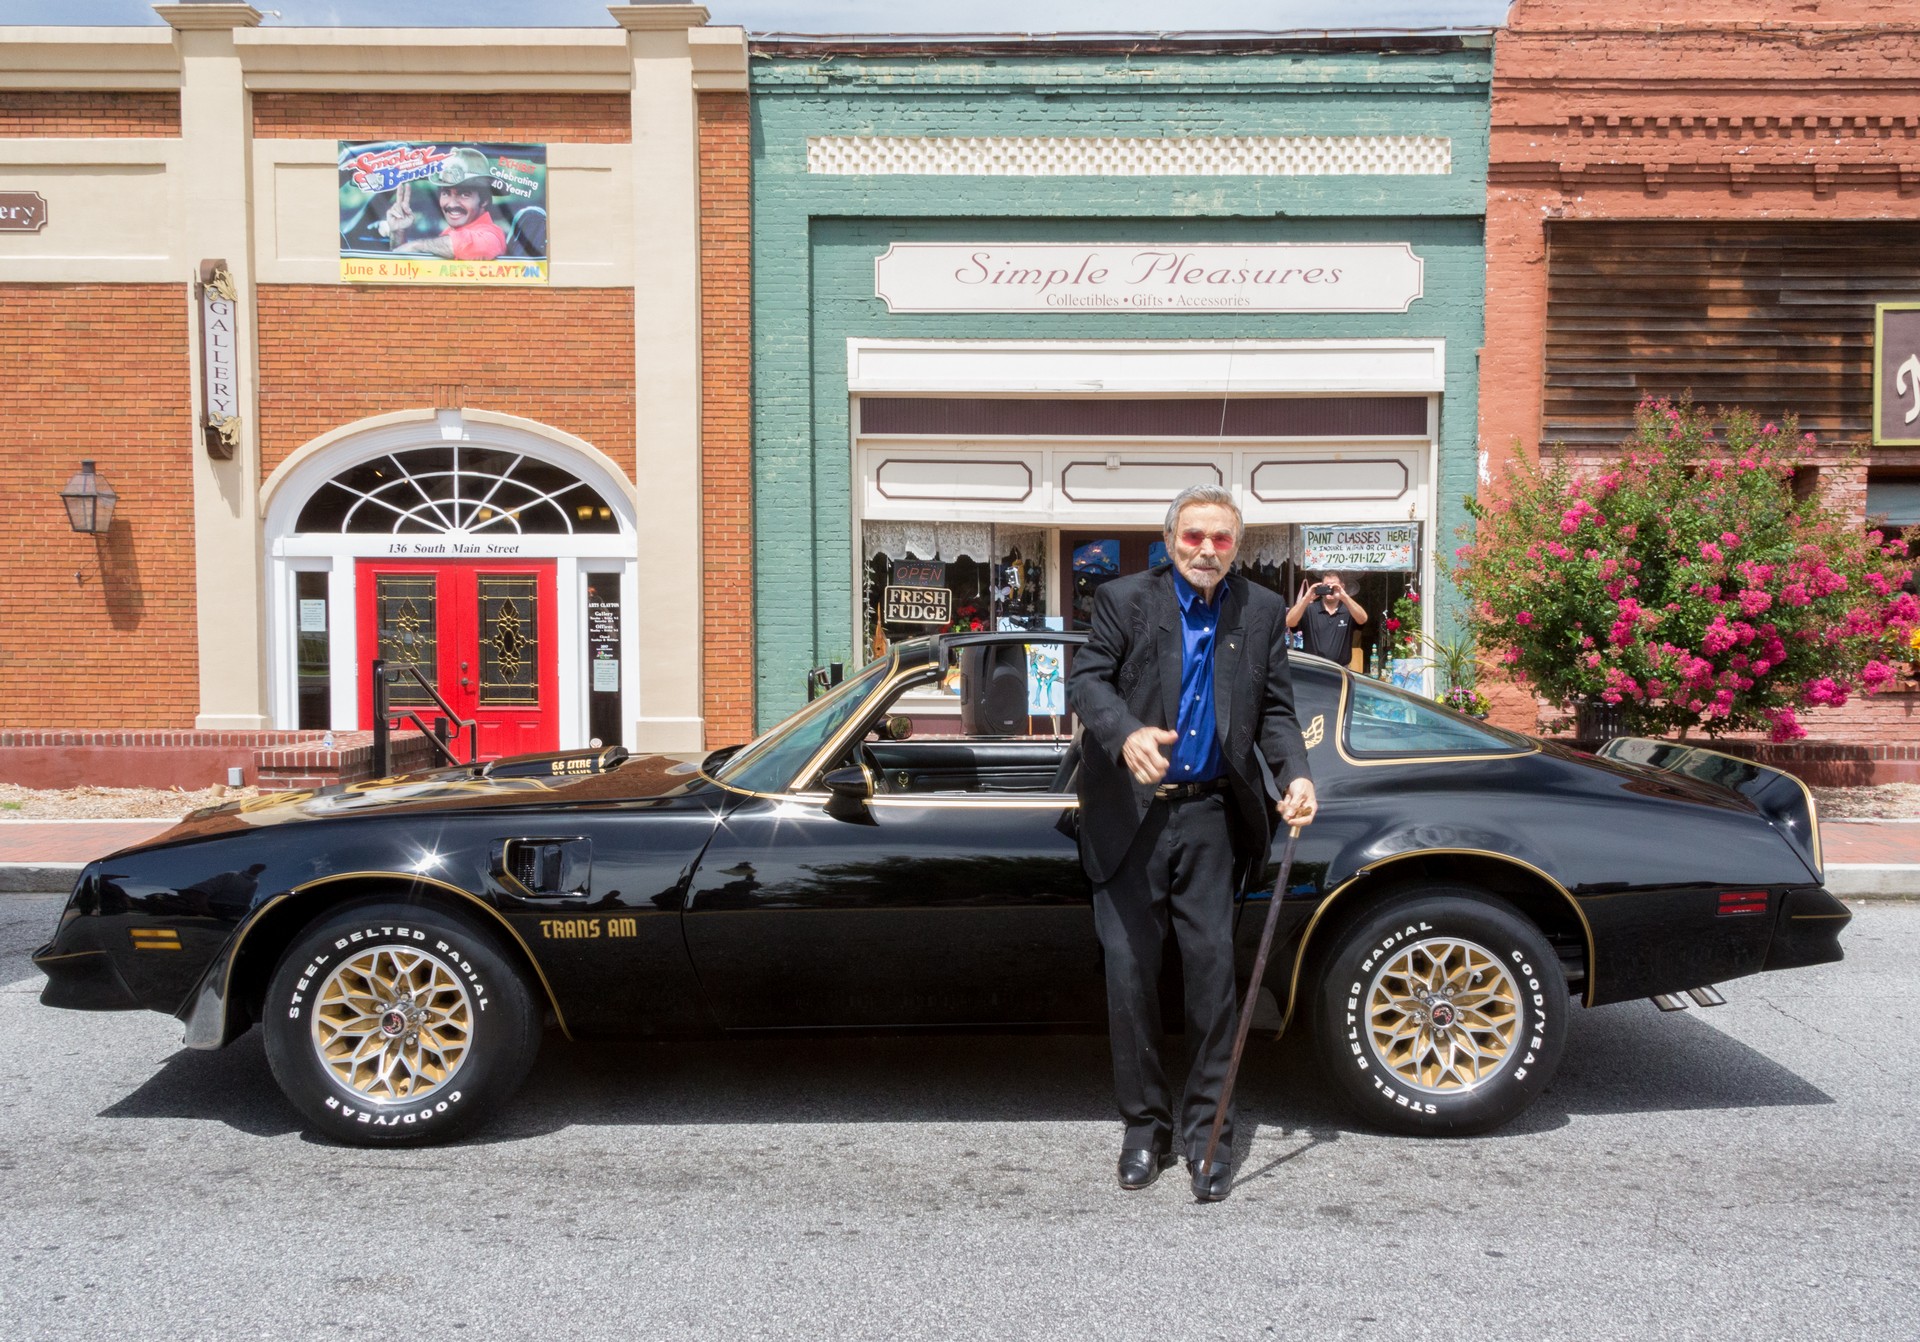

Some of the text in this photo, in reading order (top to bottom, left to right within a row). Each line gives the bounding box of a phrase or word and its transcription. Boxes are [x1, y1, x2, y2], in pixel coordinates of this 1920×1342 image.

[345, 146, 450, 175] Smokey
[498, 155, 537, 175] EXHIBIT
[373, 161, 444, 191] Bandit
[489, 166, 540, 191] Celebrating
[491, 180, 533, 198] 40 Years!
[344, 262, 374, 276] June
[378, 264, 389, 275] &
[392, 262, 419, 280] July
[439, 265, 475, 277] ARTS
[479, 265, 541, 278] CLAYTON
[954, 252, 1343, 295] Simple Pleasures
[1046, 293, 1250, 307] Collectibles Gifts Accessories
[209, 301, 232, 412] GALLERY
[1307, 529, 1411, 546] PAINT CLASSES HERE!
[1376, 543, 1393, 551] CALL
[388, 543, 519, 554] 136 South Main Street
[896, 566, 942, 581] OPEN
[890, 589, 946, 605] FRESH
[888, 604, 947, 620] FUDGE
[567, 759, 592, 769] LITRE
[539, 918, 637, 938] TRANS AM
[289, 927, 489, 1019] STEEL BELTED RADIAL
[1347, 922, 1437, 1115] STEEL BELTED RADIAL
[1511, 950, 1546, 1081] GOODYEAR
[325, 1090, 463, 1126] GOODYEAR
